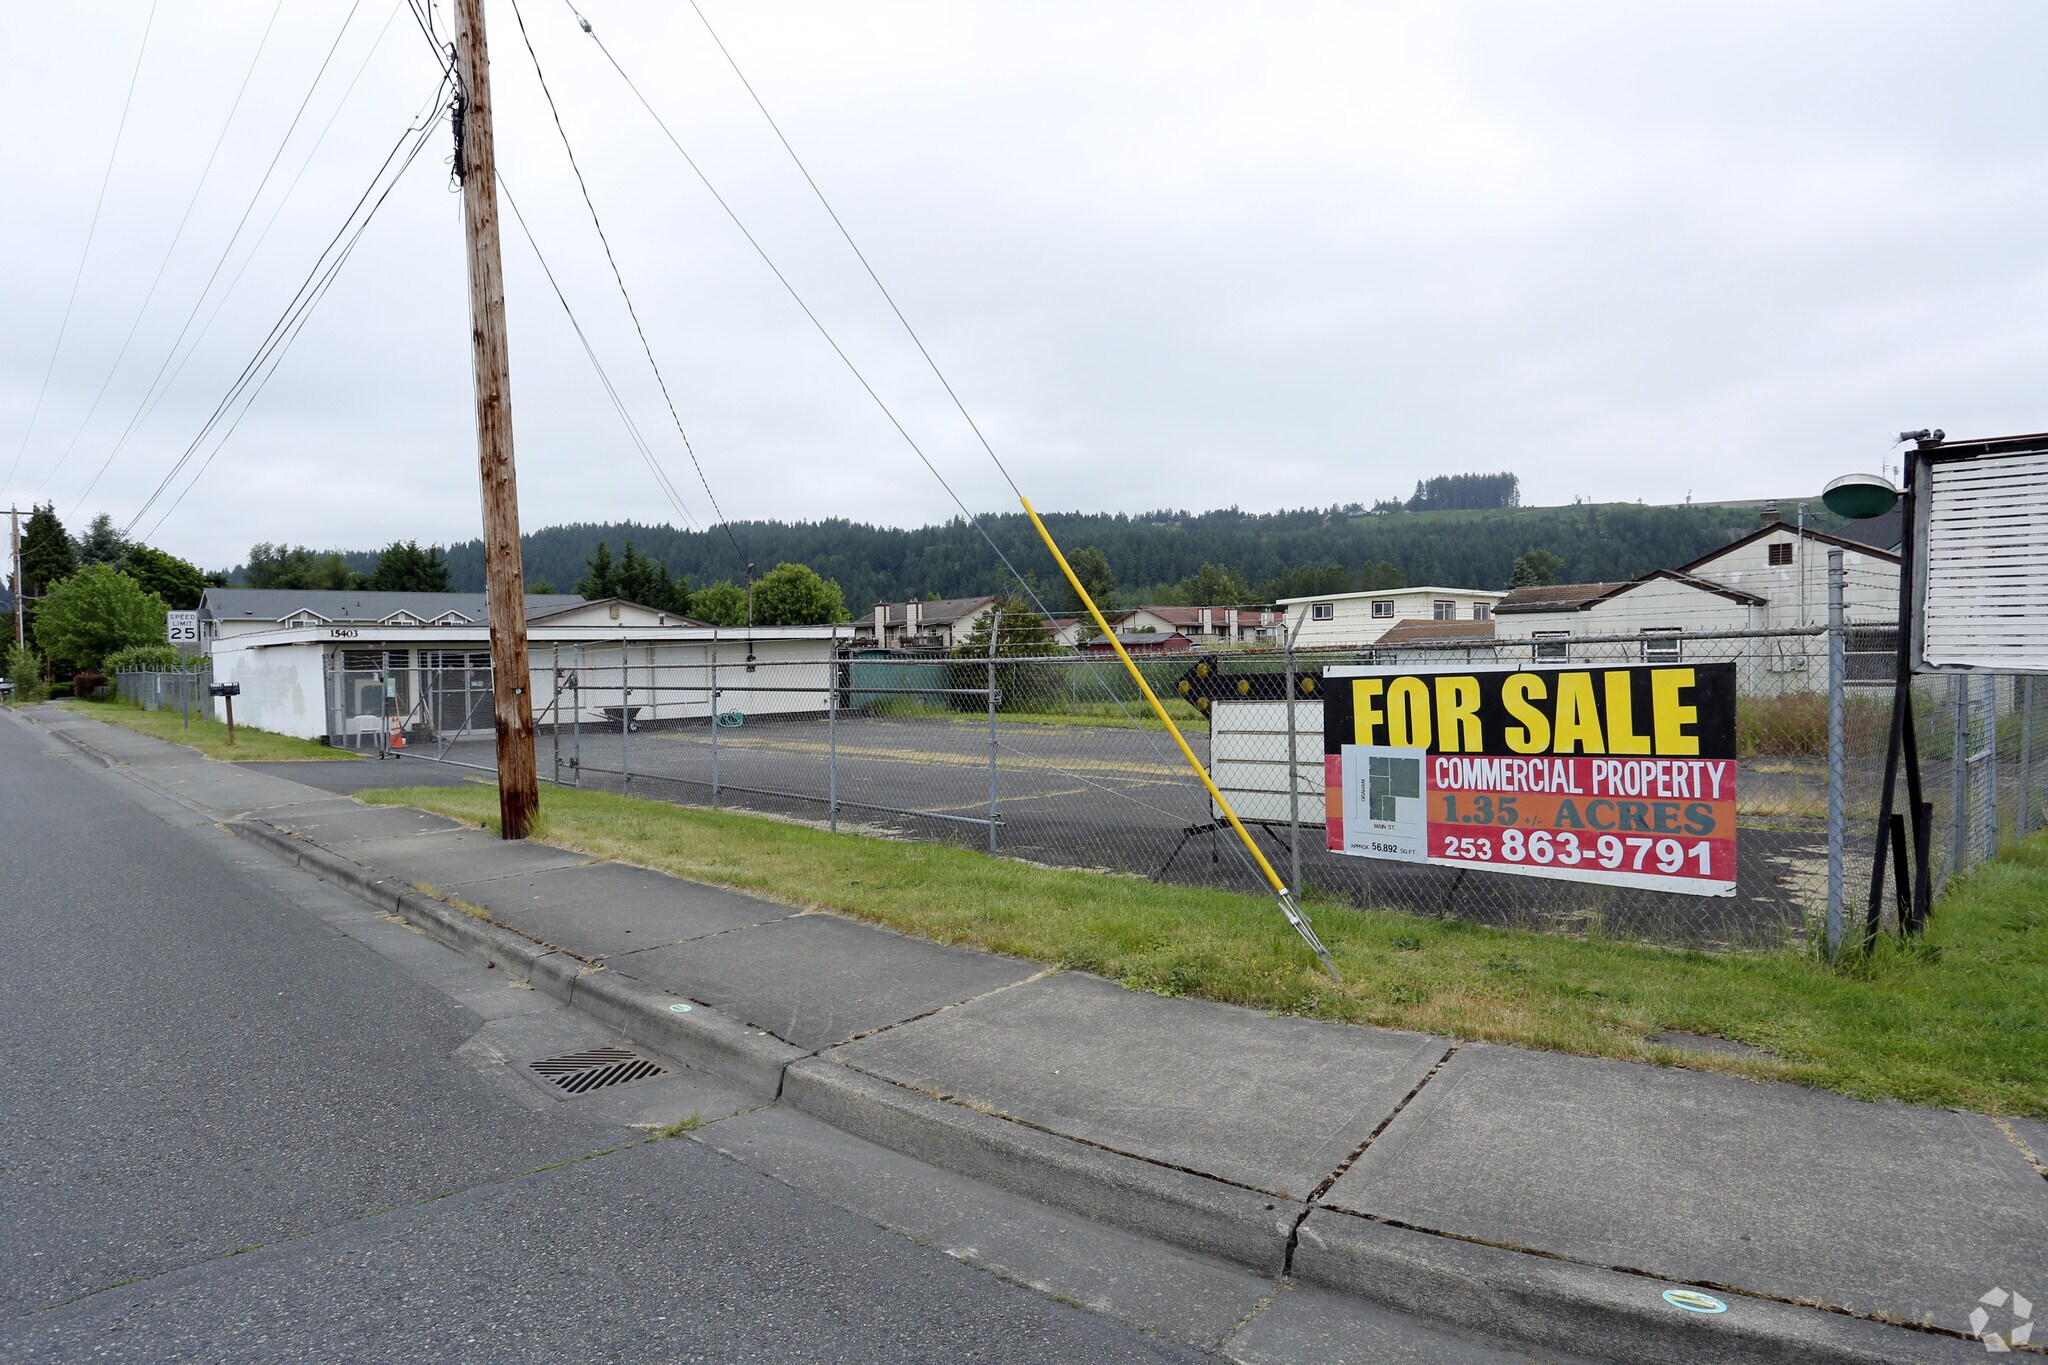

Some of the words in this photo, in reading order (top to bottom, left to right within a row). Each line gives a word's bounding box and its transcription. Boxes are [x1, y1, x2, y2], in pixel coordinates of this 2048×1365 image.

[170, 627, 196, 640] 25
[330, 629, 359, 638] 15403
[1352, 675, 1484, 753] FOR
[1501, 667, 1700, 756] SALE
[1434, 757, 1584, 795] COMMERCIAL
[1592, 758, 1726, 799] PROPERTY
[1442, 794, 1519, 827] 1.35
[1553, 798, 1716, 837] ACRES
[1372, 842, 1397, 853] 56,892
[1444, 836, 1493, 861] 253
[1500, 828, 1712, 876] 863-9791
